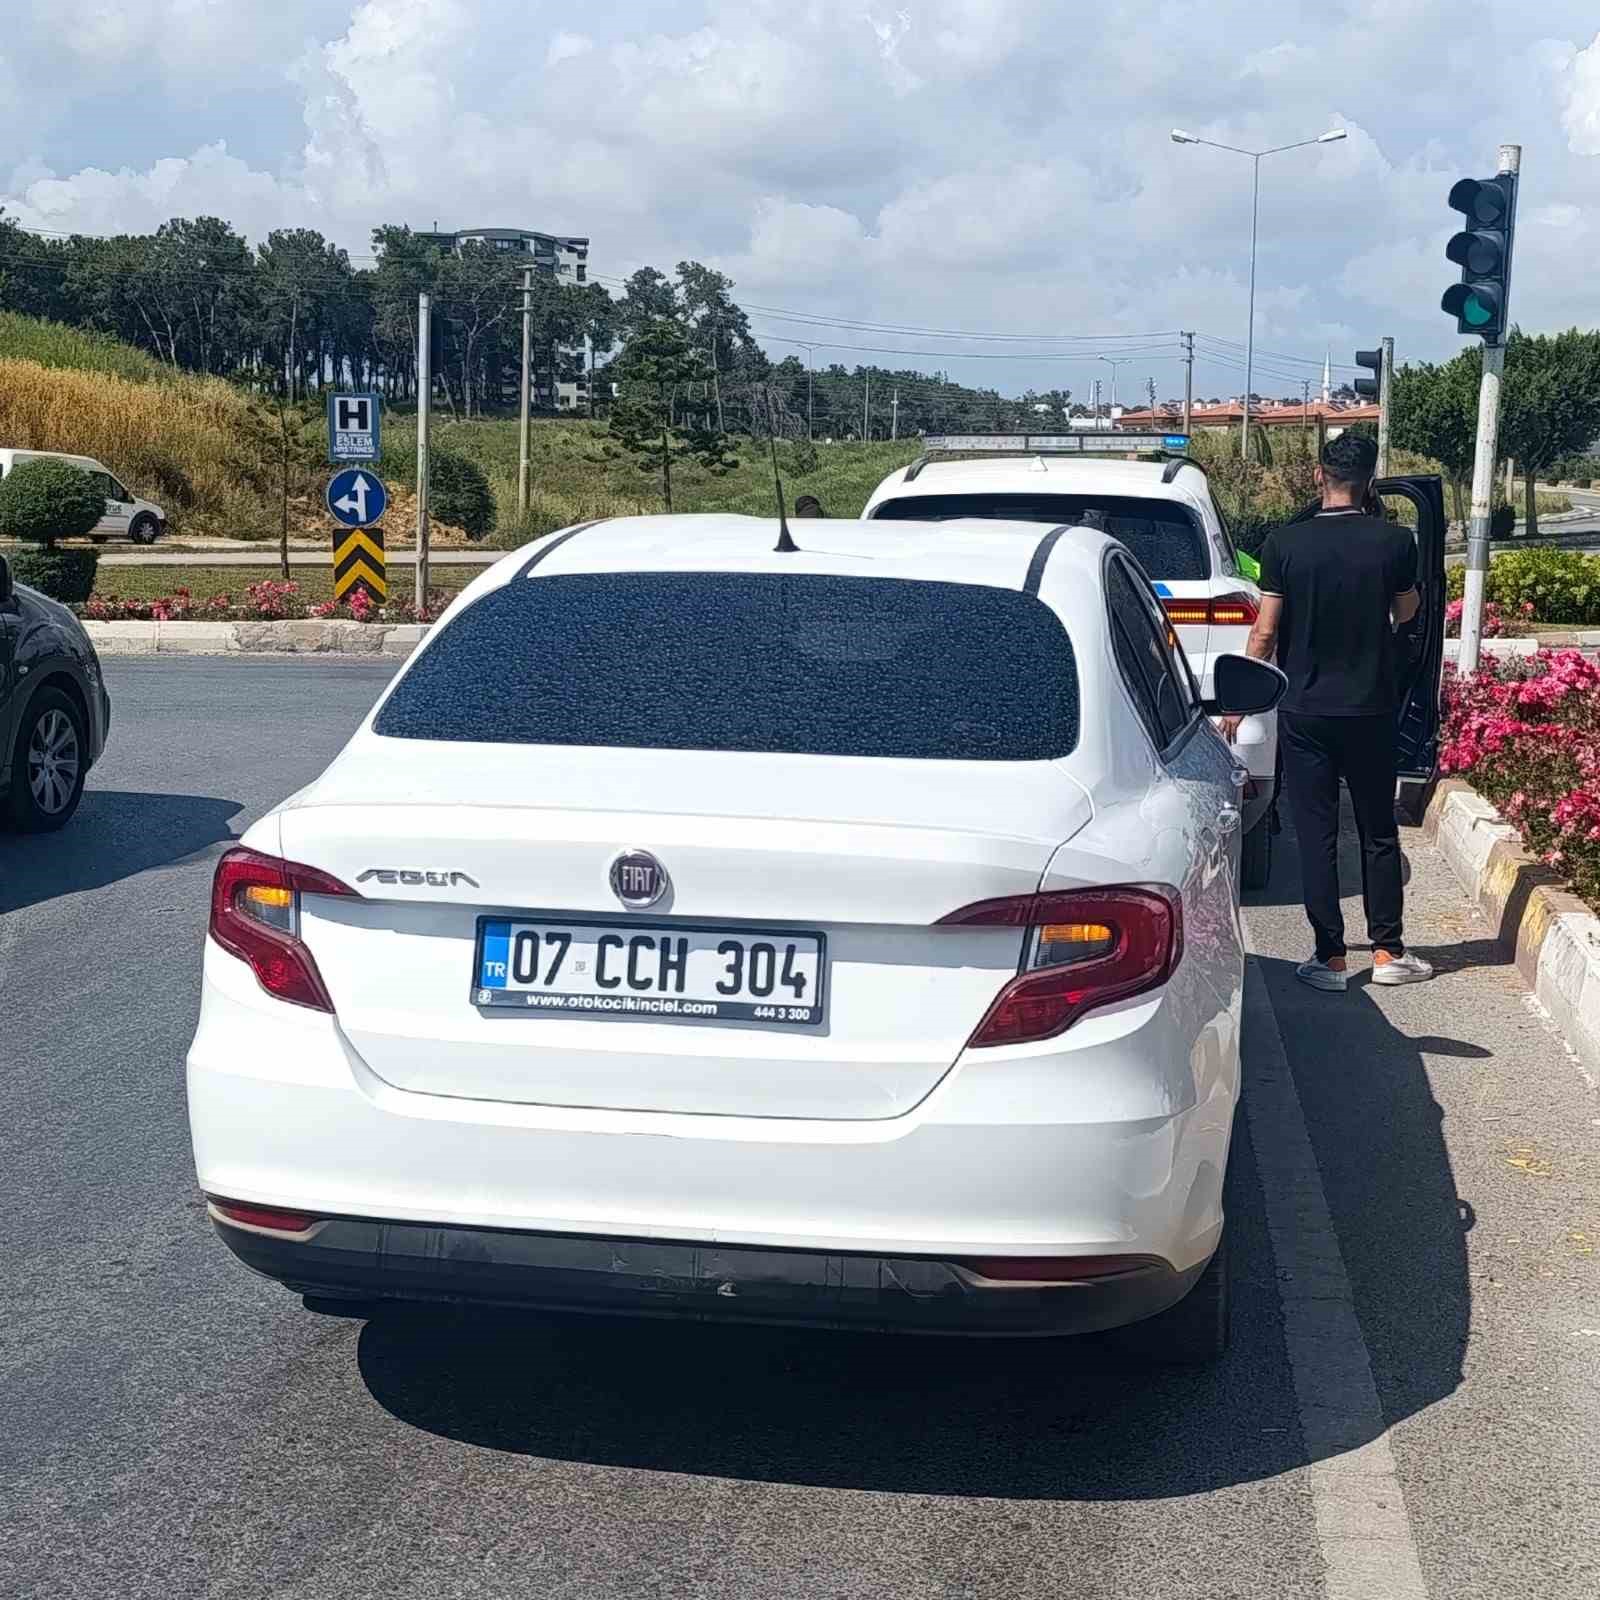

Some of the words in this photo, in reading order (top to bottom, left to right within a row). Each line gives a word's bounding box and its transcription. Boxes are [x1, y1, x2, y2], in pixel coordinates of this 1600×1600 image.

[339, 400, 368, 430] H
[622, 866, 653, 892] FIAT
[485, 962, 506, 977] TR
[513, 930, 572, 986] 07
[595, 935, 688, 993] CCH
[716, 941, 807, 998] 304
[526, 994, 718, 1015] www.otokocikinciel.com
[754, 1006, 775, 1017] 444
[777, 1007, 786, 1019] 3
[788, 1008, 810, 1020] 300
